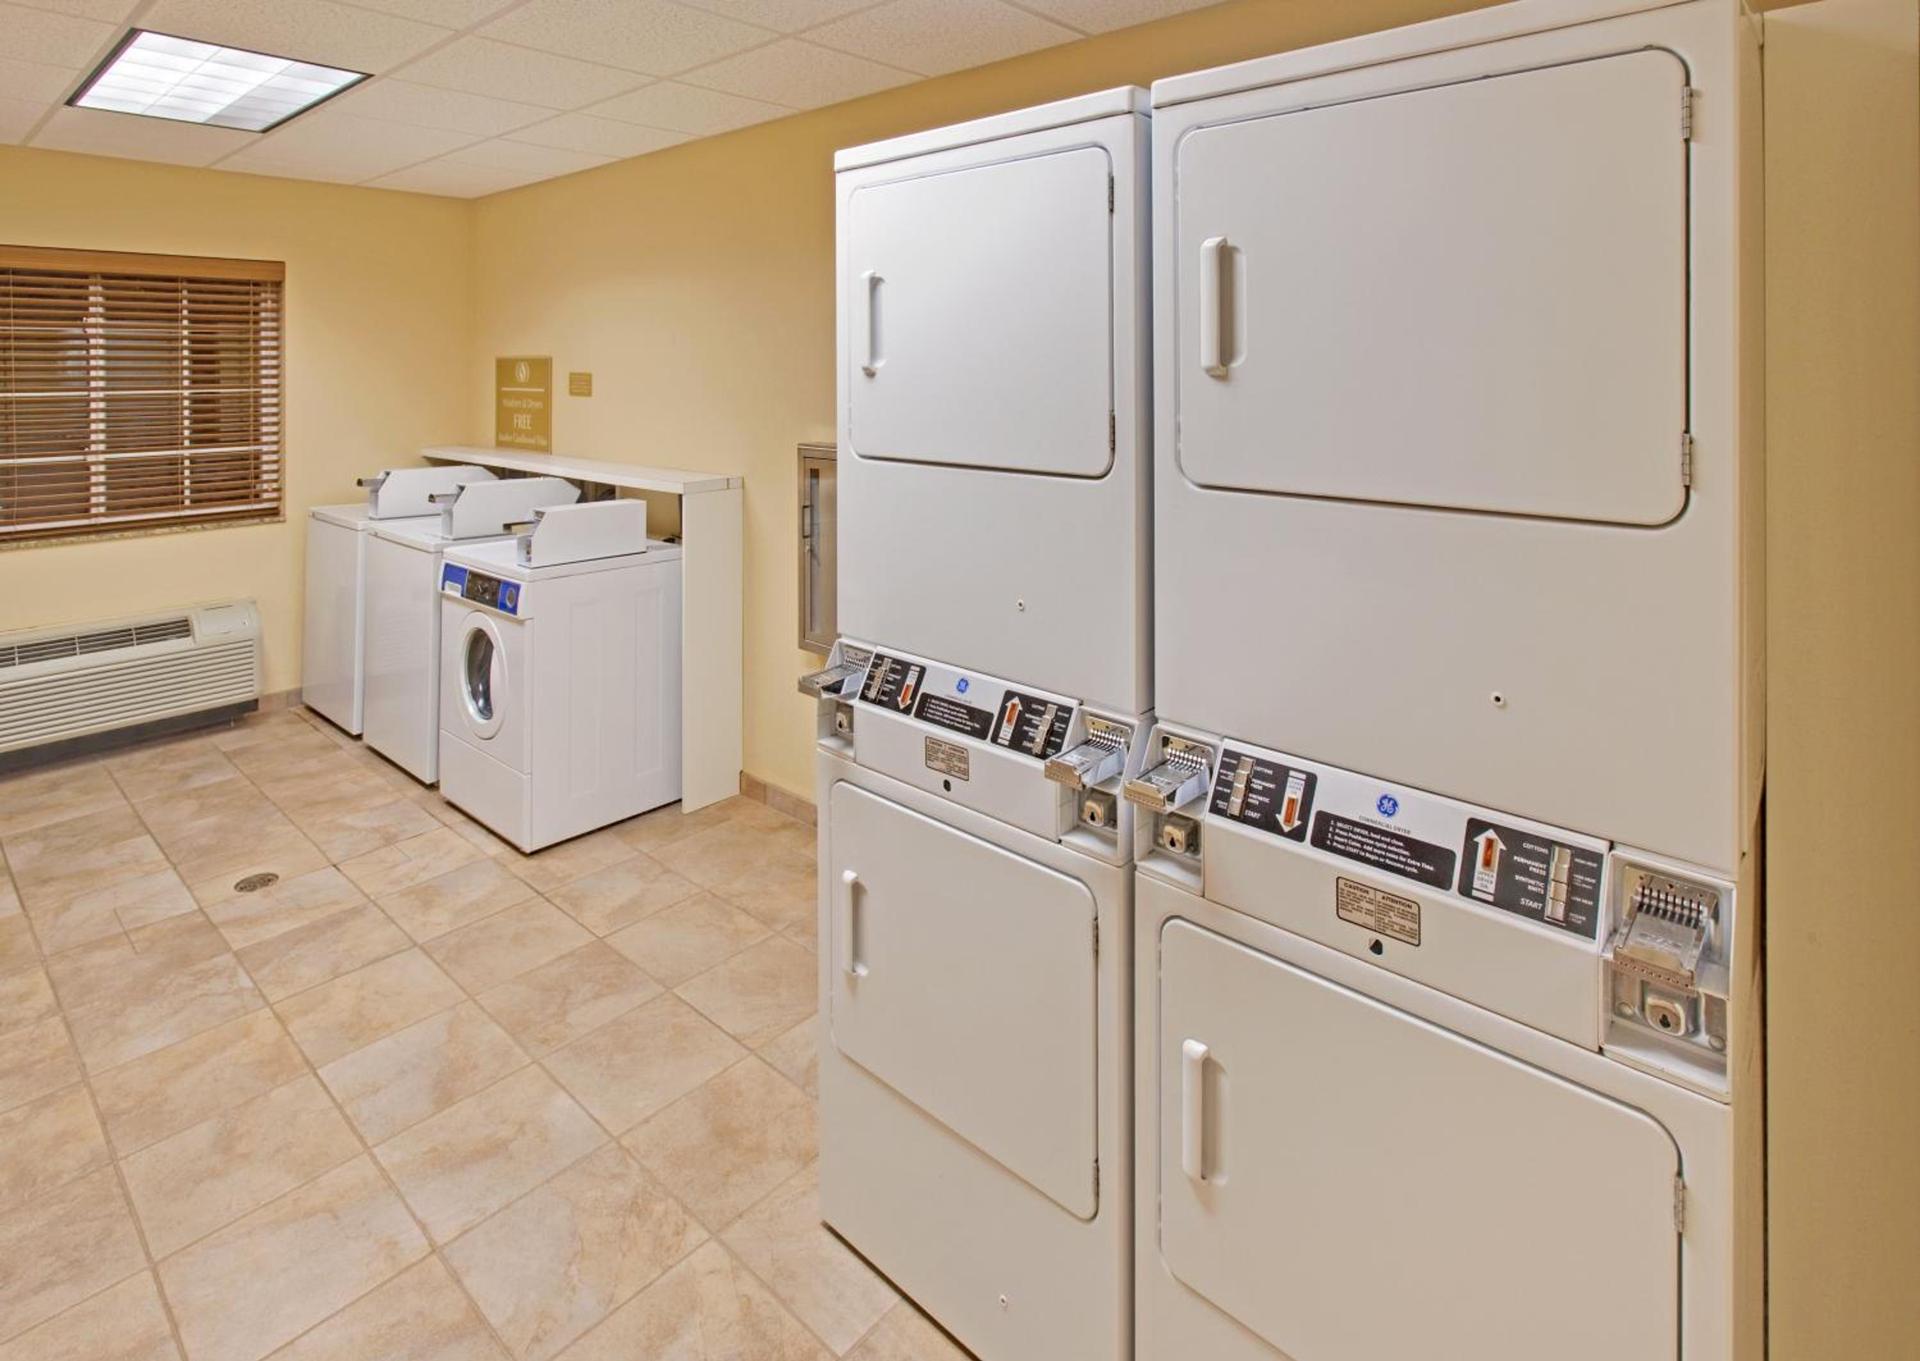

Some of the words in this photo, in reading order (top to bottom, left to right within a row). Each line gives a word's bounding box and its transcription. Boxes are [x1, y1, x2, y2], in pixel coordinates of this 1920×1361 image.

[513, 413, 532, 430] FREE
[1378, 795, 1397, 816] GE
[1522, 842, 1549, 854] COTTONS
[1513, 856, 1548, 869] PERMANENT
[1529, 866, 1546, 876] PRESS
[1514, 874, 1546, 888] SYNTHETIC
[1344, 882, 1370, 894] CAUTION
[1528, 885, 1545, 894] KNITS
[1382, 896, 1412, 909] ATTENTION
[1520, 898, 1543, 910] START
